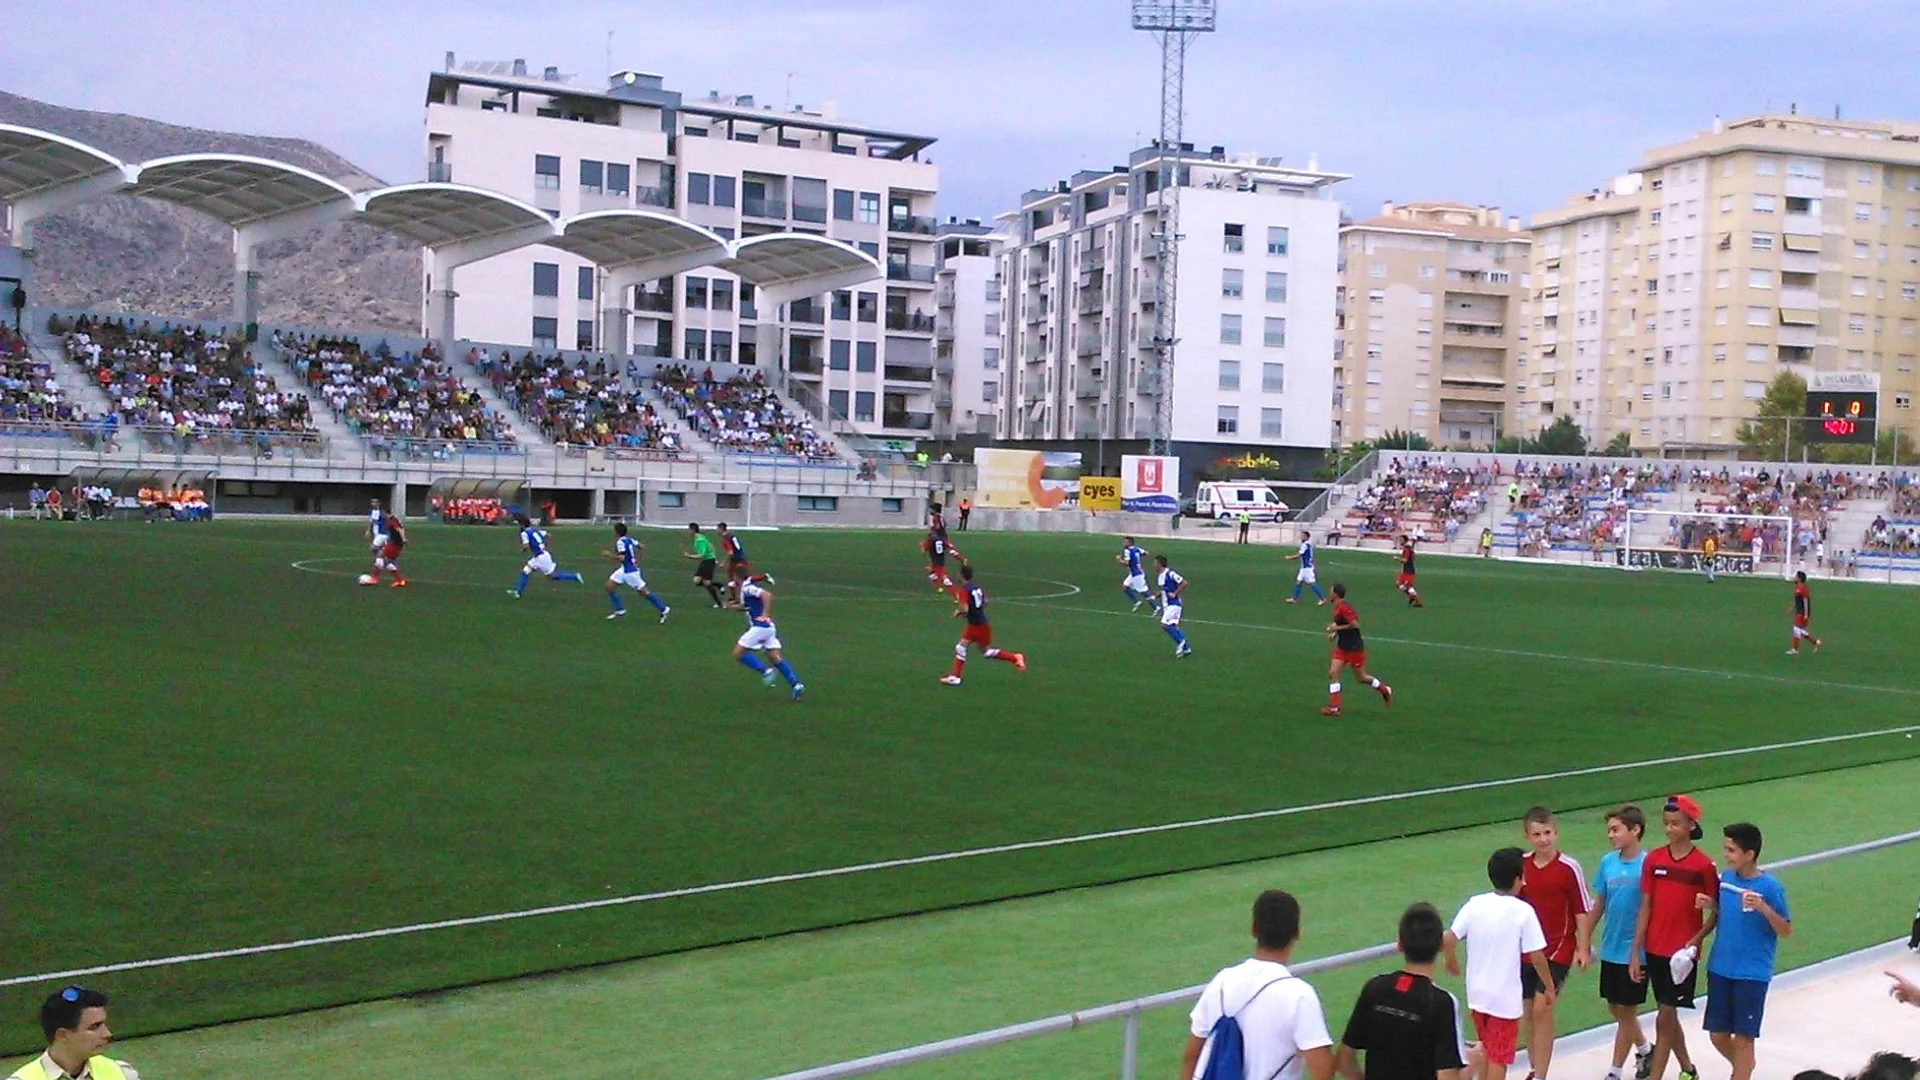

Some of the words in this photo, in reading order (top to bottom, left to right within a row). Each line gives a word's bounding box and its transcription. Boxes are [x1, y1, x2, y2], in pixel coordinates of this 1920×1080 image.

[1851, 401, 1860, 415] 0
[1084, 484, 1115, 499] cyes
[935, 540, 944, 555] 6
